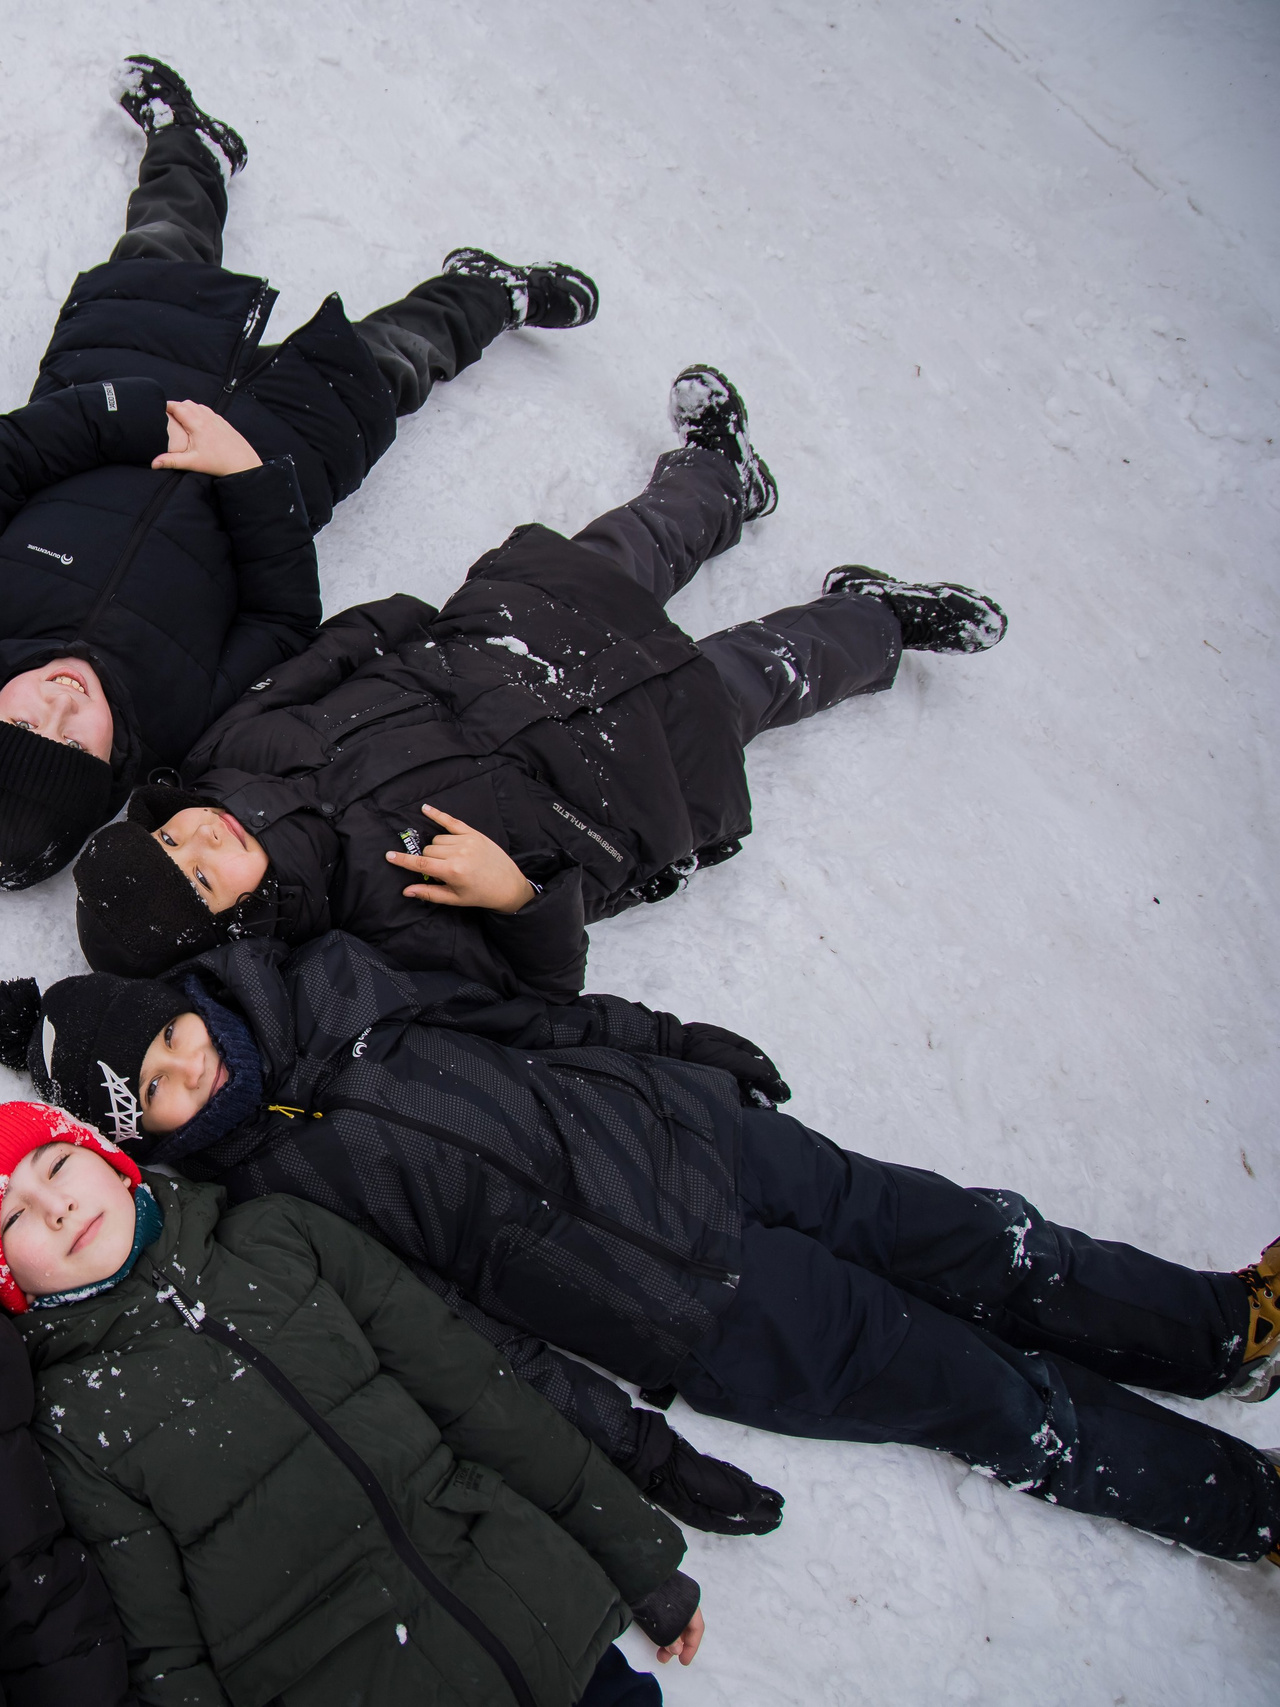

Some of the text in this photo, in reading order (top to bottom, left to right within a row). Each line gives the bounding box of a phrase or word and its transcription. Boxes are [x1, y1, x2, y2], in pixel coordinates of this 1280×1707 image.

[26, 543, 61, 559] OUTVENTURE
[552, 802, 587, 831] ATHLETIC
[182, 1308, 200, 1329] EXTREME
